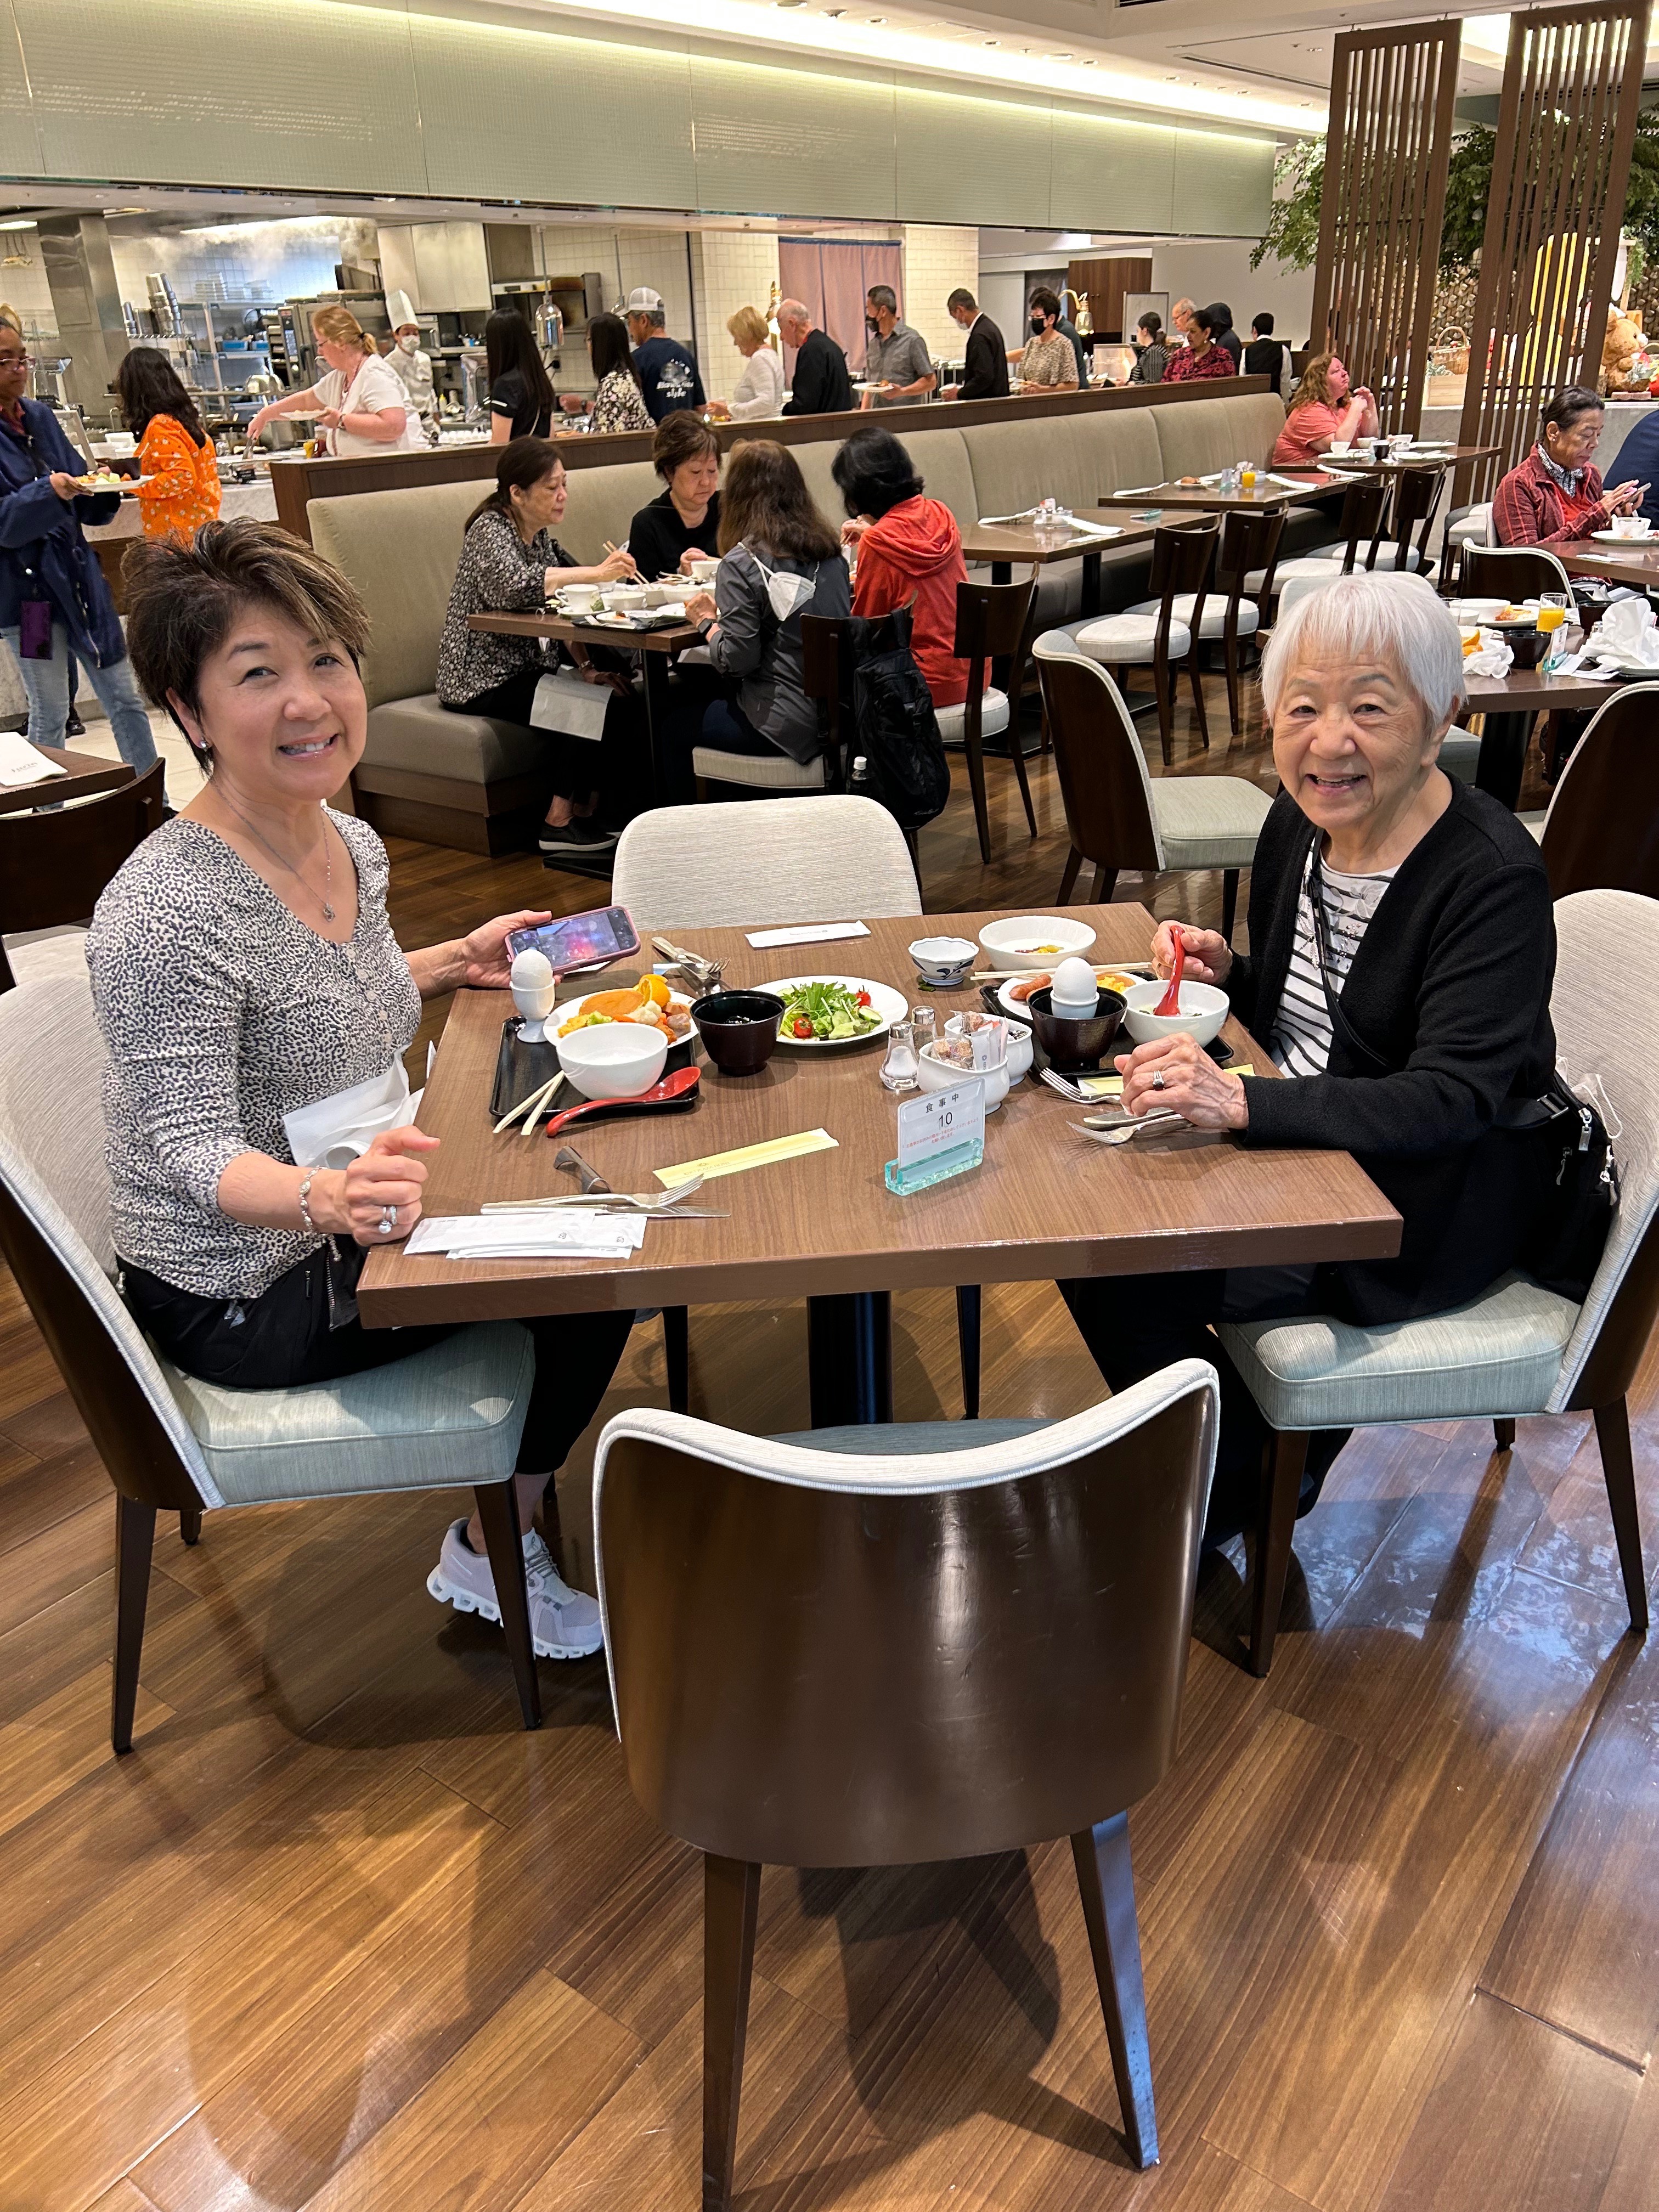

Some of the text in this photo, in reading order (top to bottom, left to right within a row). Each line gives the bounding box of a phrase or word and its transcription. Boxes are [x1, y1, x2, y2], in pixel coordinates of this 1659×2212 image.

[926, 1093, 959, 1113] 食事中
[939, 1111, 952, 1127] 10
